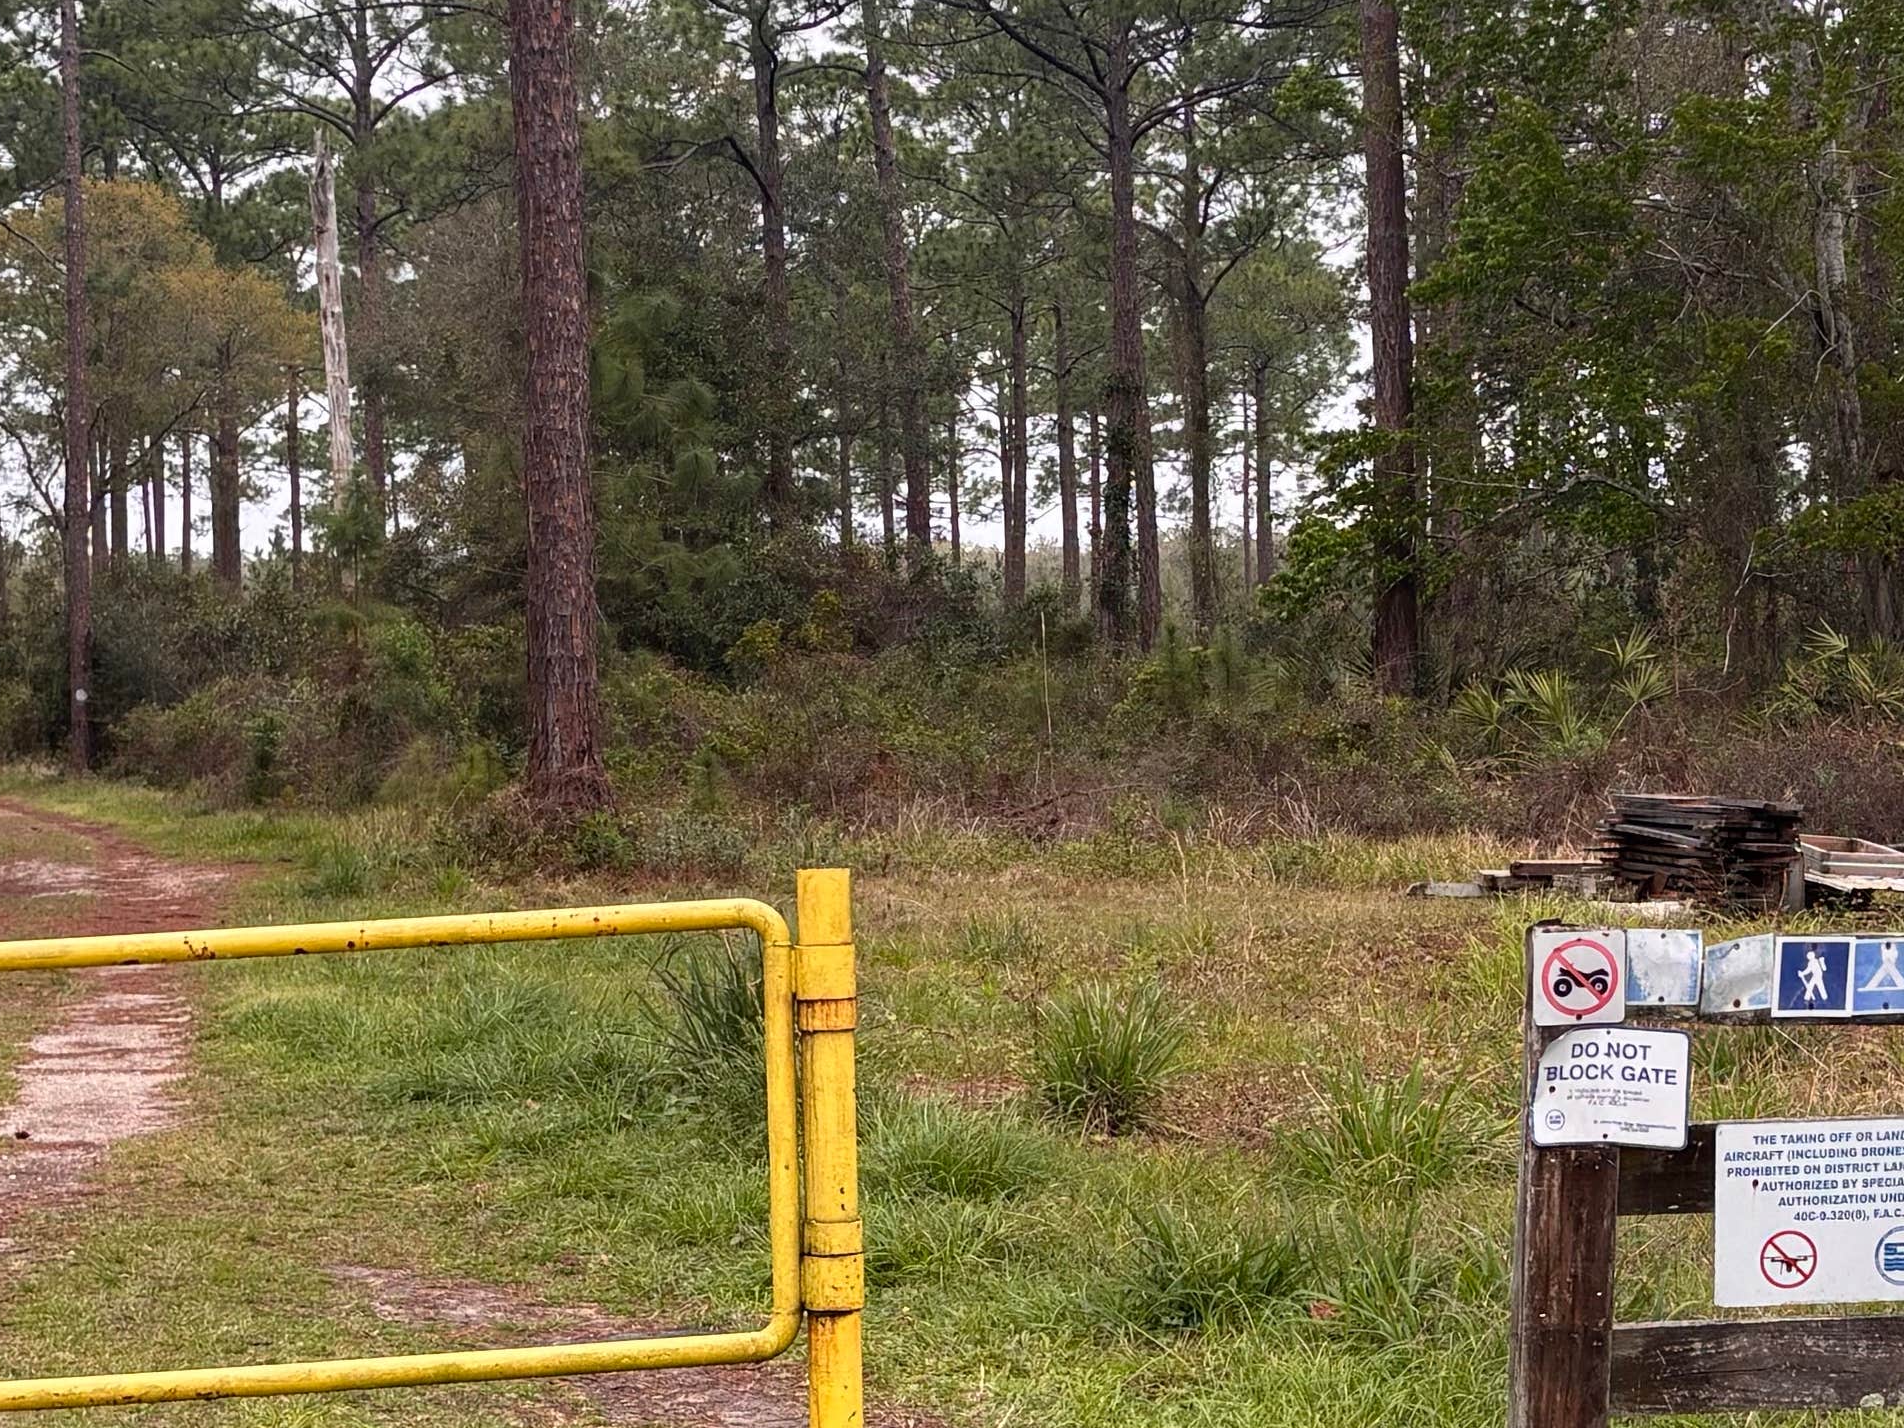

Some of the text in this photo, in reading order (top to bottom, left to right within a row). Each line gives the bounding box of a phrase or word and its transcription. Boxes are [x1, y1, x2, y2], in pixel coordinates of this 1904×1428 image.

[1571, 1042, 1652, 1061] DO NOT
[1545, 1064, 1678, 1085] BLOCK GATE
[1753, 1135, 1777, 1145] THE
[1781, 1133, 1825, 1145] TAKING
[1830, 1132, 1852, 1143] OFF
[1856, 1131, 1873, 1142] OR
[1724, 1150, 1785, 1162] AIRCRAFT
[1787, 1148, 1857, 1162] (INCLUDING
[1727, 1165, 1800, 1177] PROHIBITED
[1803, 1164, 1821, 1175] ON
[1825, 1162, 1880, 1174] DISTRICT
[1761, 1179, 1838, 1191] AUTHORIZED
[1842, 1178, 1858, 1189] BY
[1778, 1194, 1876, 1207] AUTHORIZATION
[1874, 1207, 1904, 1219] F.A.C.
